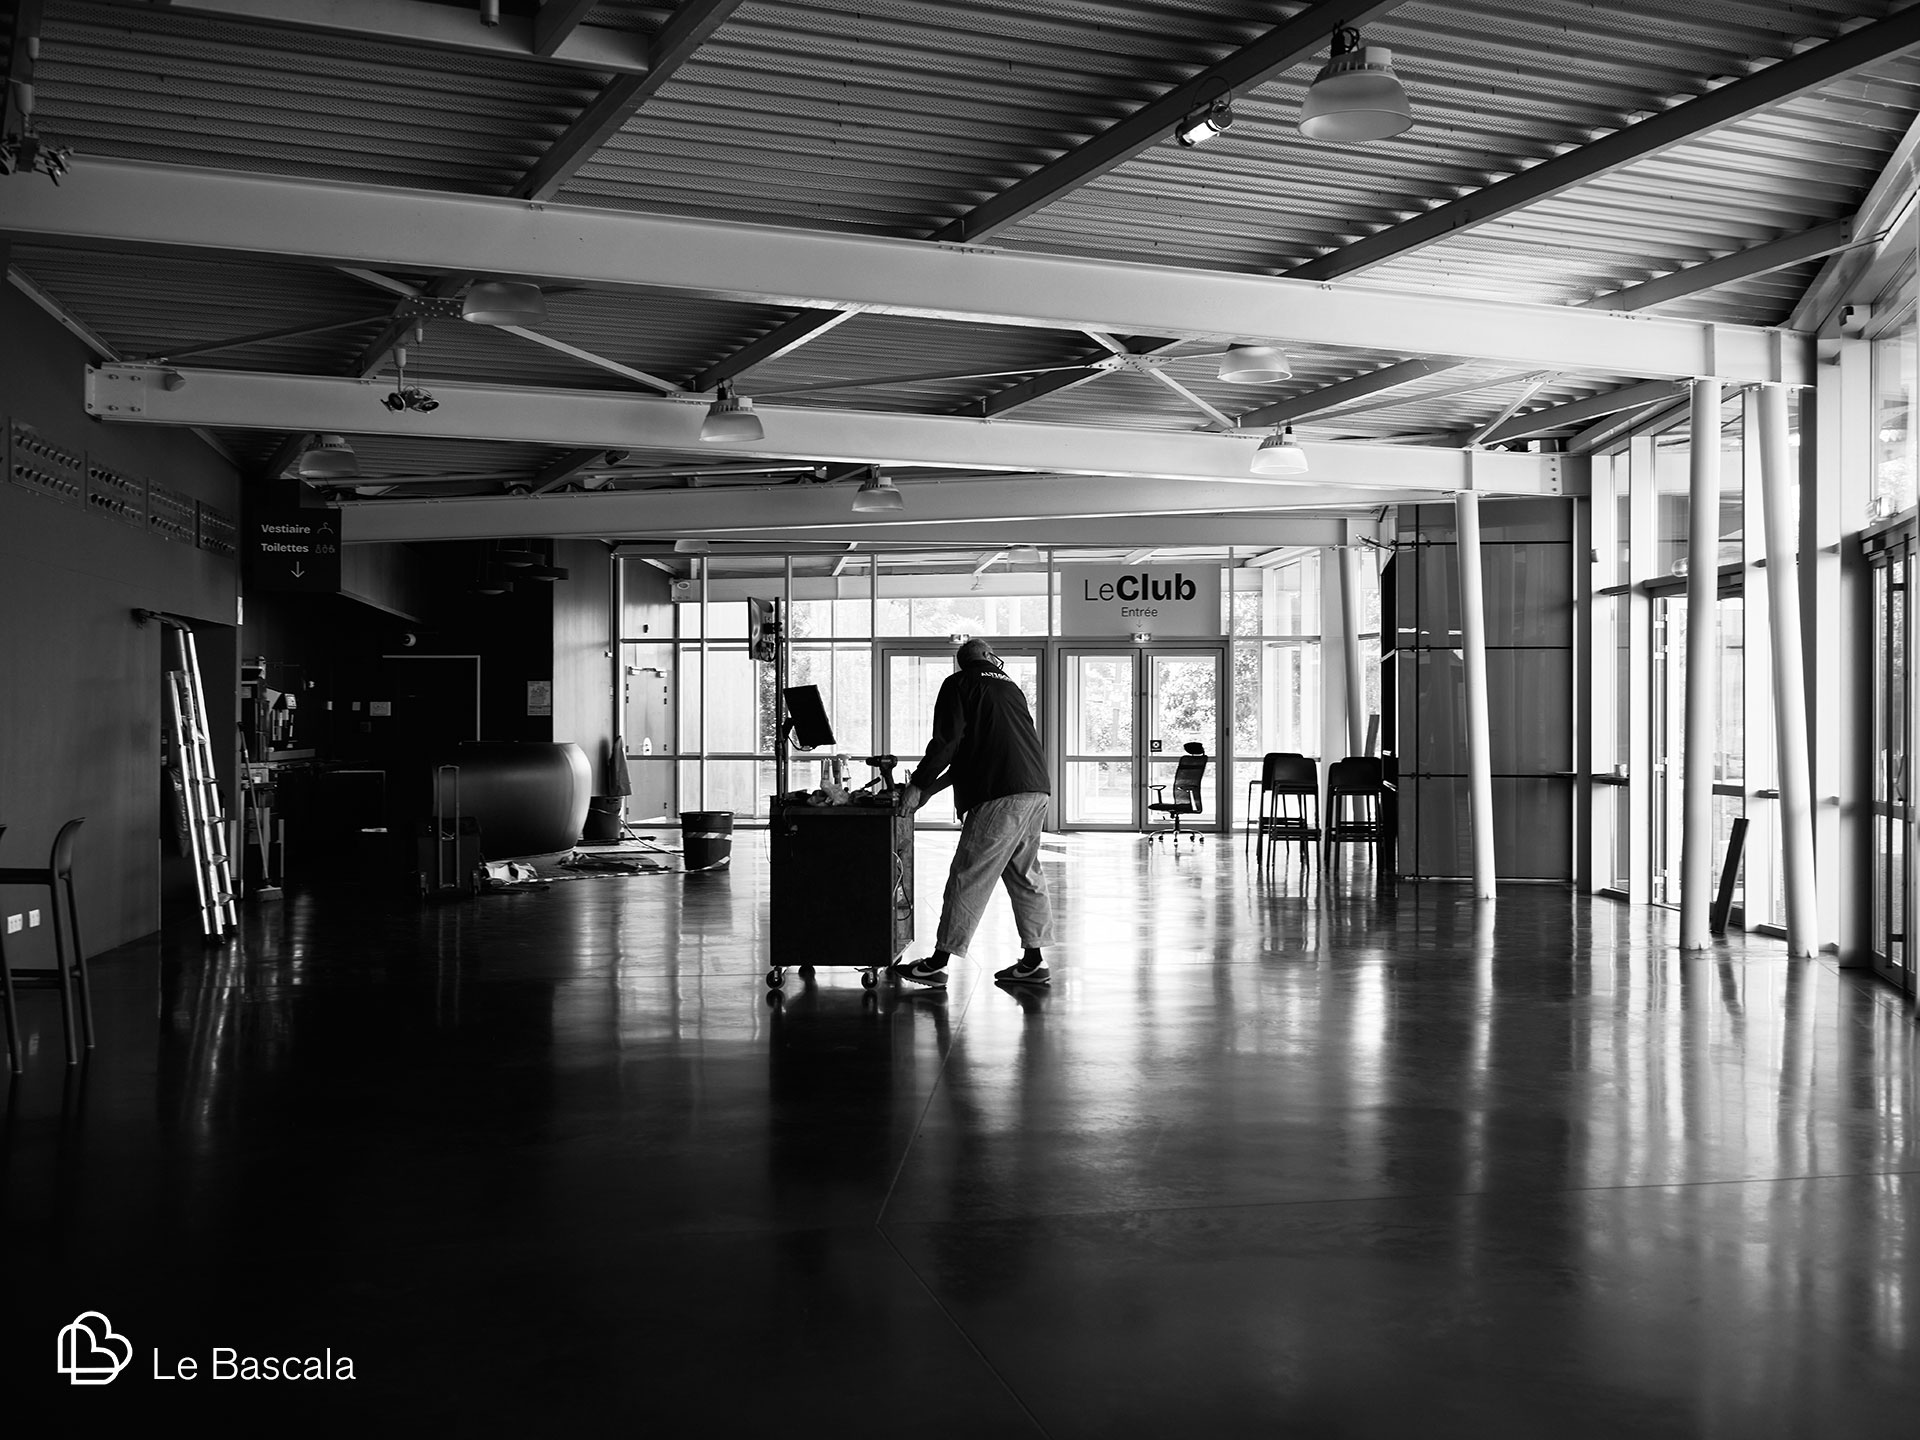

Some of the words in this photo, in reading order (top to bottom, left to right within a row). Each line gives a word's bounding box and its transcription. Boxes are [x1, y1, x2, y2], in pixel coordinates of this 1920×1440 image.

[260, 524, 311, 534] Vestiaire
[260, 543, 310, 553] Toilettes
[1121, 606, 1158, 617] Entrée
